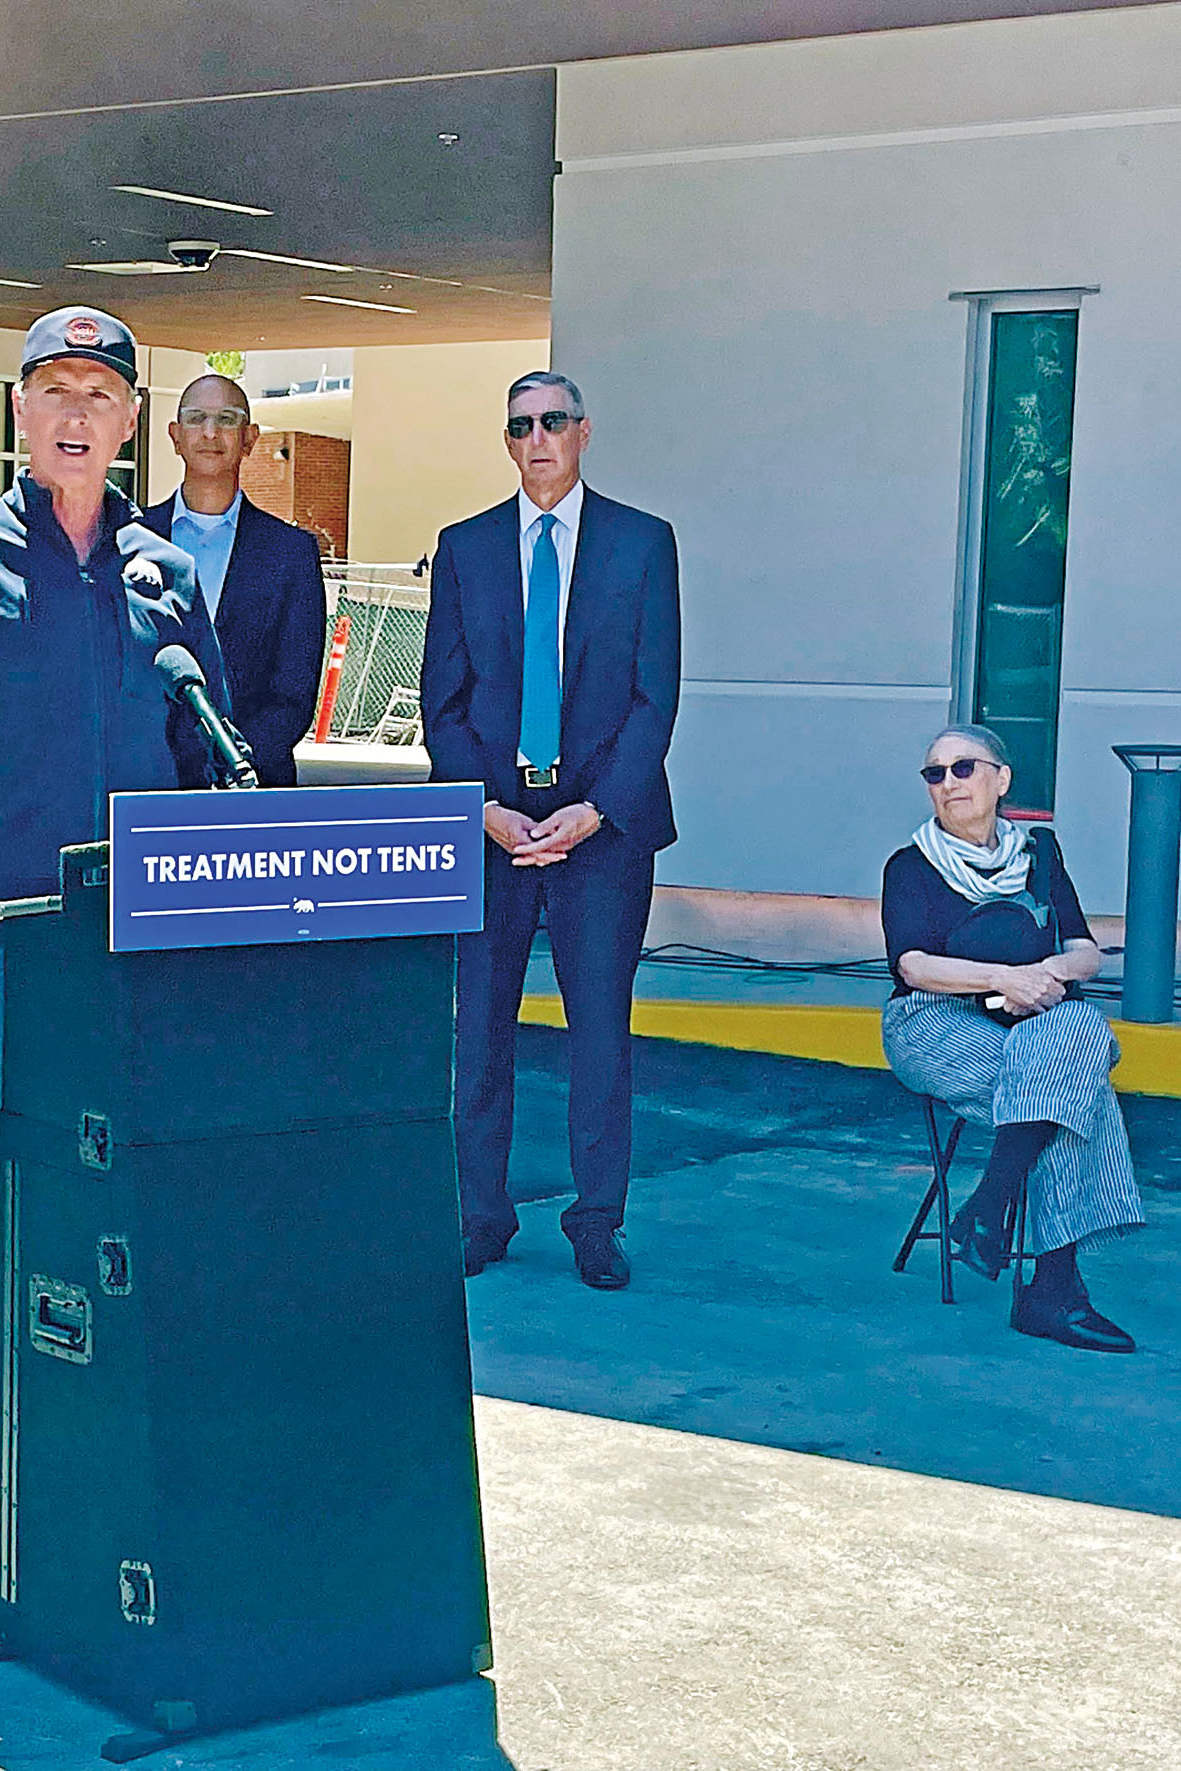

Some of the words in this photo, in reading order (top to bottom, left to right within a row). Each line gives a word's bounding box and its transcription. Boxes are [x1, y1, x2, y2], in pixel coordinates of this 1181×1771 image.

[142, 850, 306, 883] TREATMENT
[312, 847, 372, 876] NOT
[377, 843, 456, 873] TENTS
